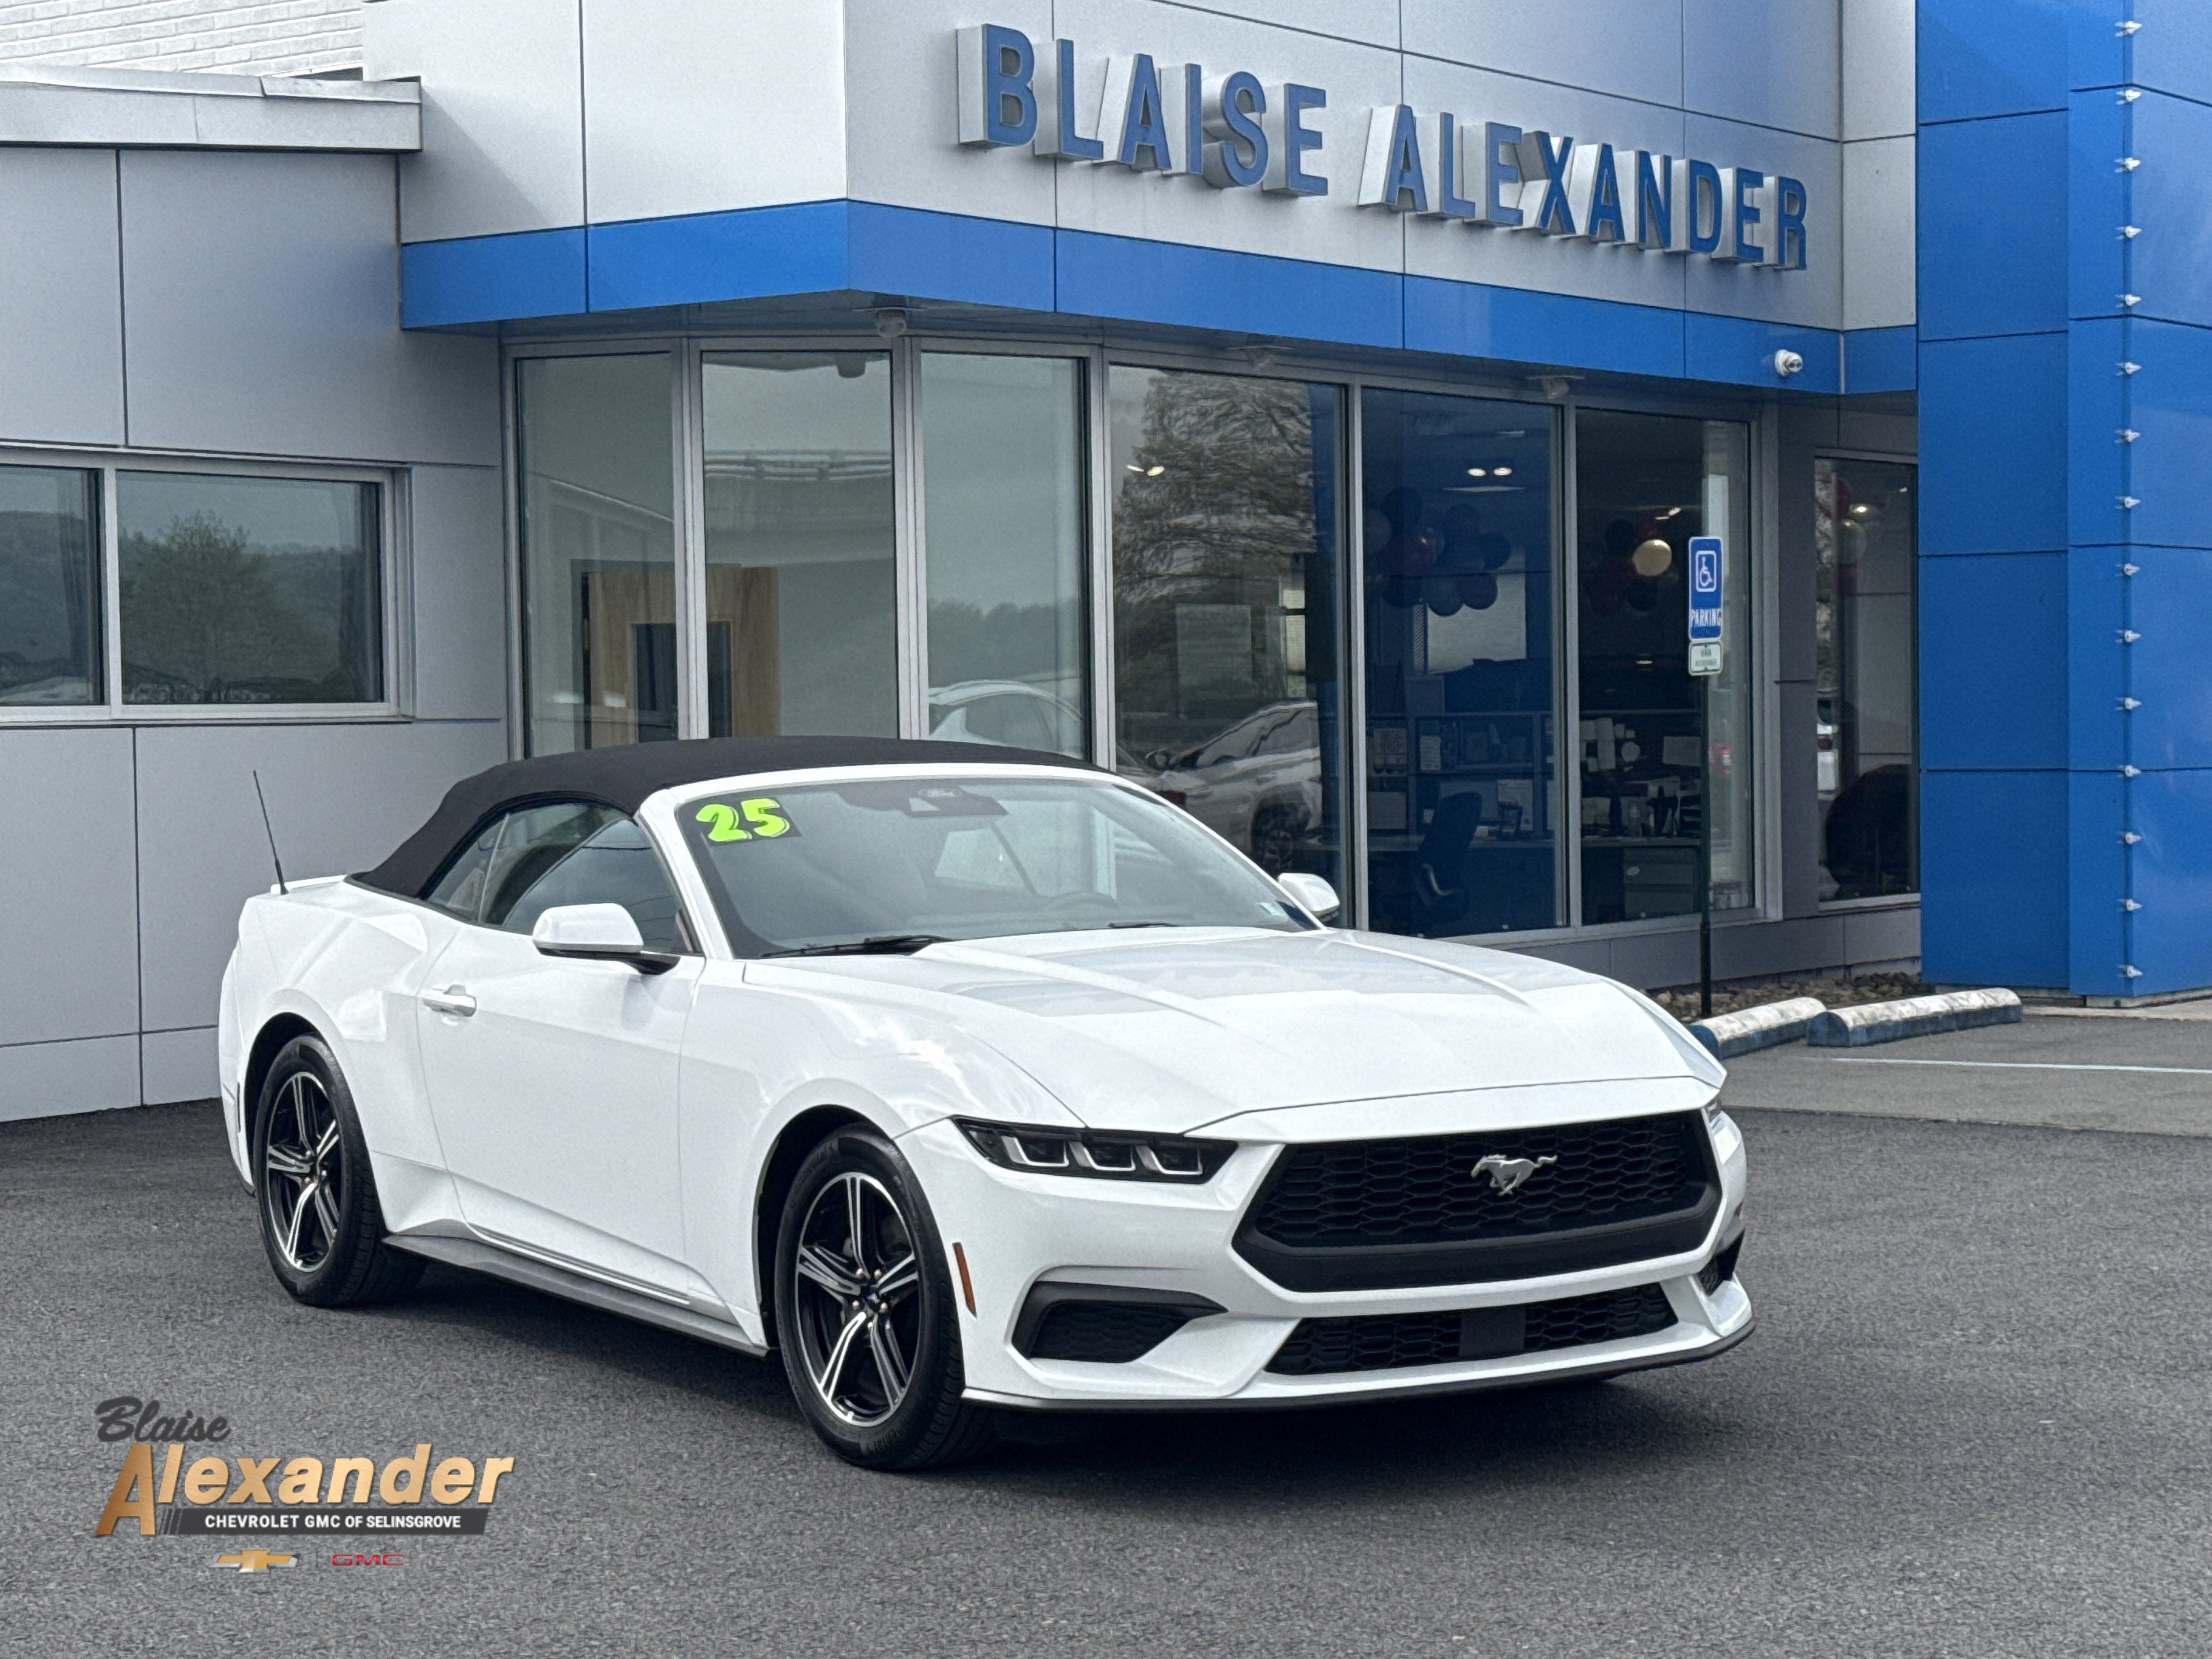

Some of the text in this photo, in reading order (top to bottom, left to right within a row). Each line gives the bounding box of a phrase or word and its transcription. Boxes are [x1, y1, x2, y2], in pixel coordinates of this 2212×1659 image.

[980, 23, 1807, 270] BLAISE ALEXANDER
[1690, 608, 1721, 627] PARKING
[696, 798, 791, 842] 25
